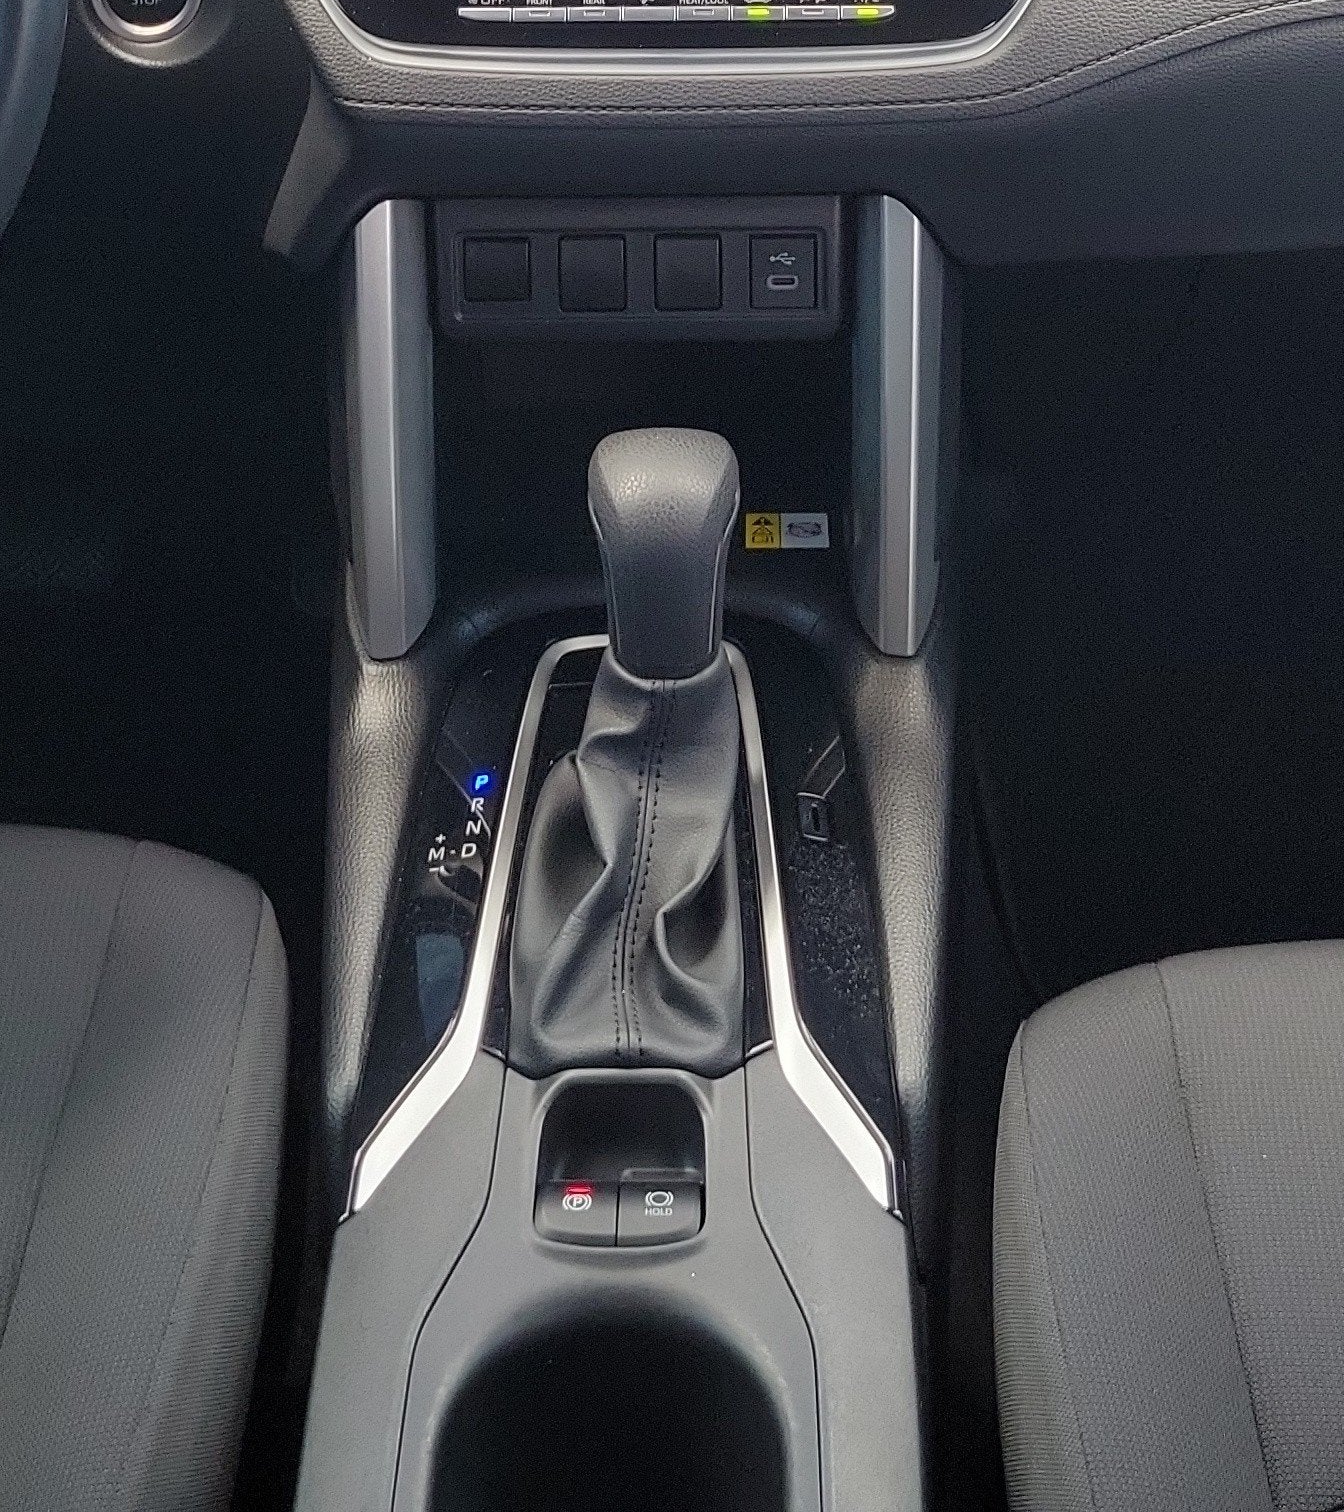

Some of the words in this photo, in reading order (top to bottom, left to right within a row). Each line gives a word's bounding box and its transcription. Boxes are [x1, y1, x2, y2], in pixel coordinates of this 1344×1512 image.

[474, 774, 489, 791] P
[471, 796, 485, 813] R
[465, 819, 482, 837] N
[427, 846, 446, 862] M
[460, 842, 477, 859] D
[645, 1208, 673, 1216] HOLD
